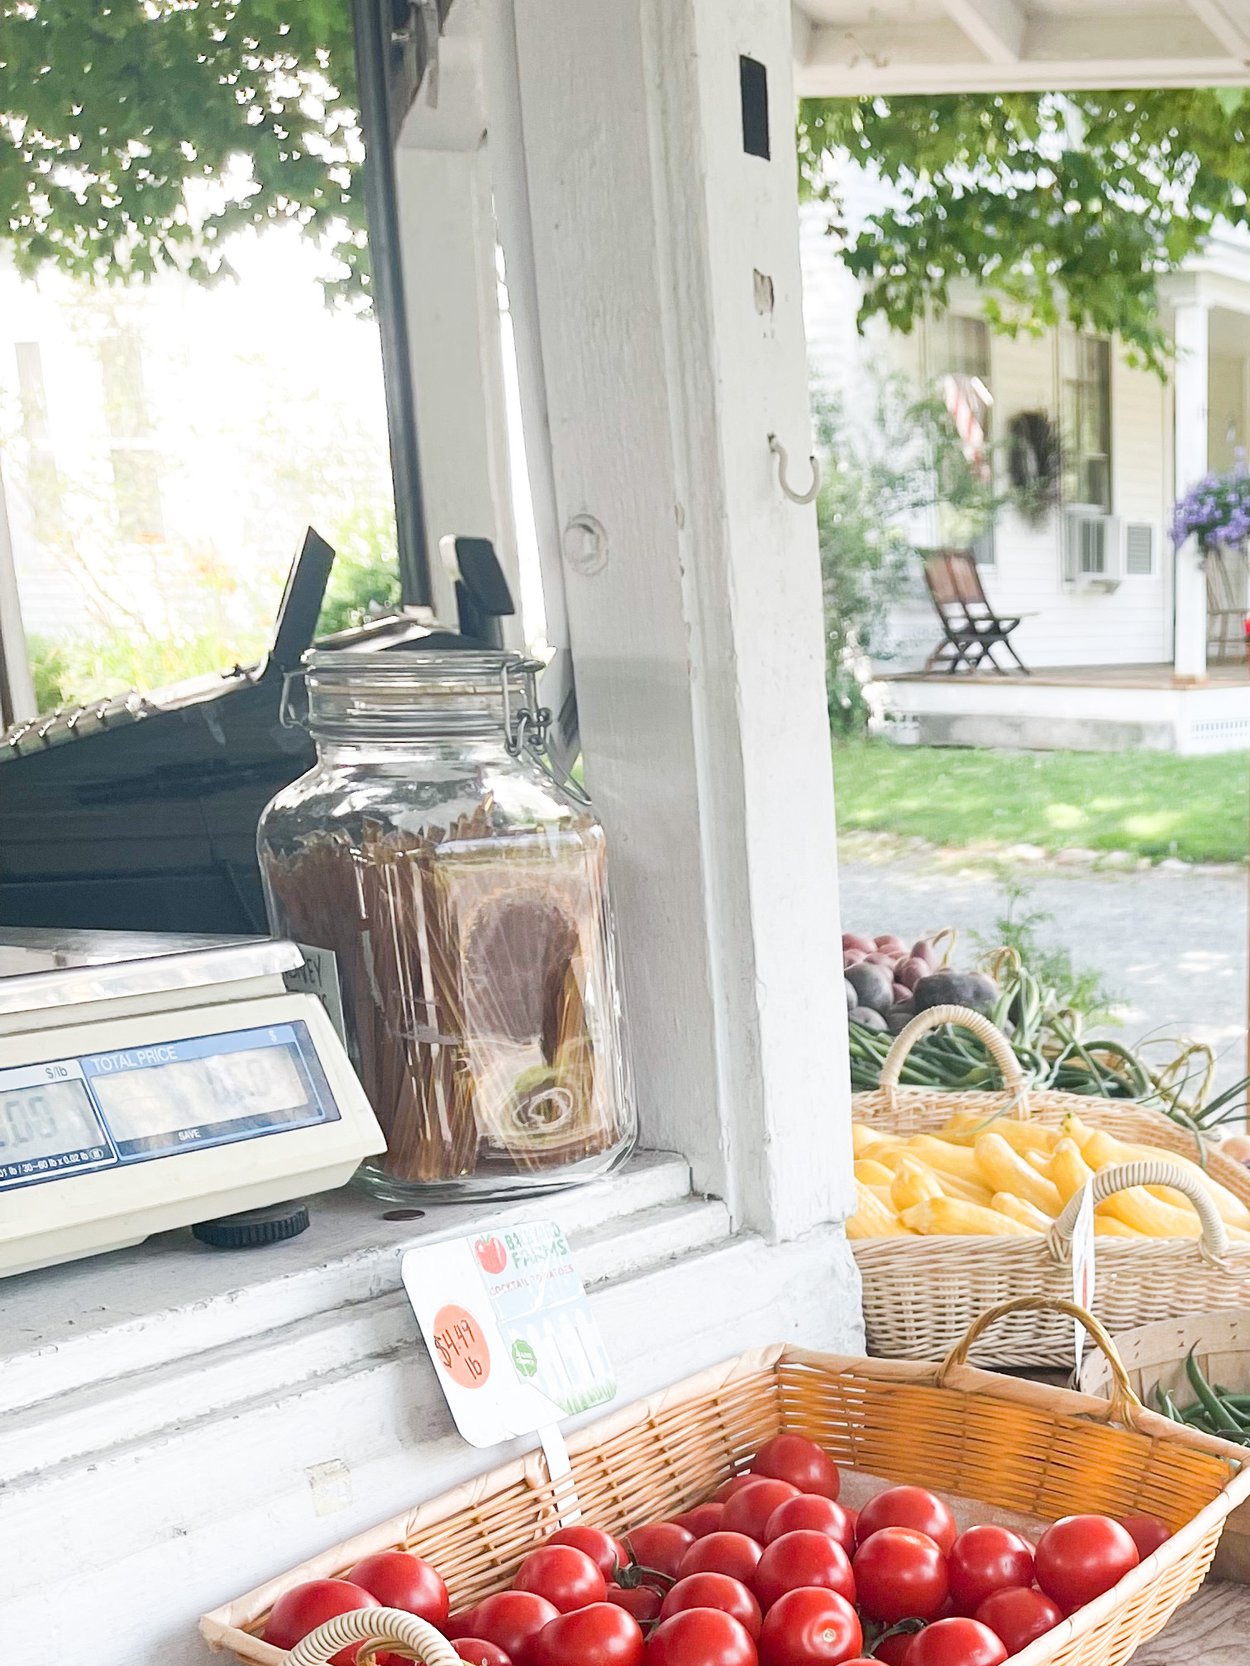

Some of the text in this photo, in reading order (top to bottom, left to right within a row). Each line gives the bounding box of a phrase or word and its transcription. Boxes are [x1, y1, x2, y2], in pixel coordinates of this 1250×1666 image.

[90, 1046, 178, 1073] TOTAL PRICE
[178, 1128, 200, 1141] SAVE
[434, 1319, 476, 1369] $4.49
